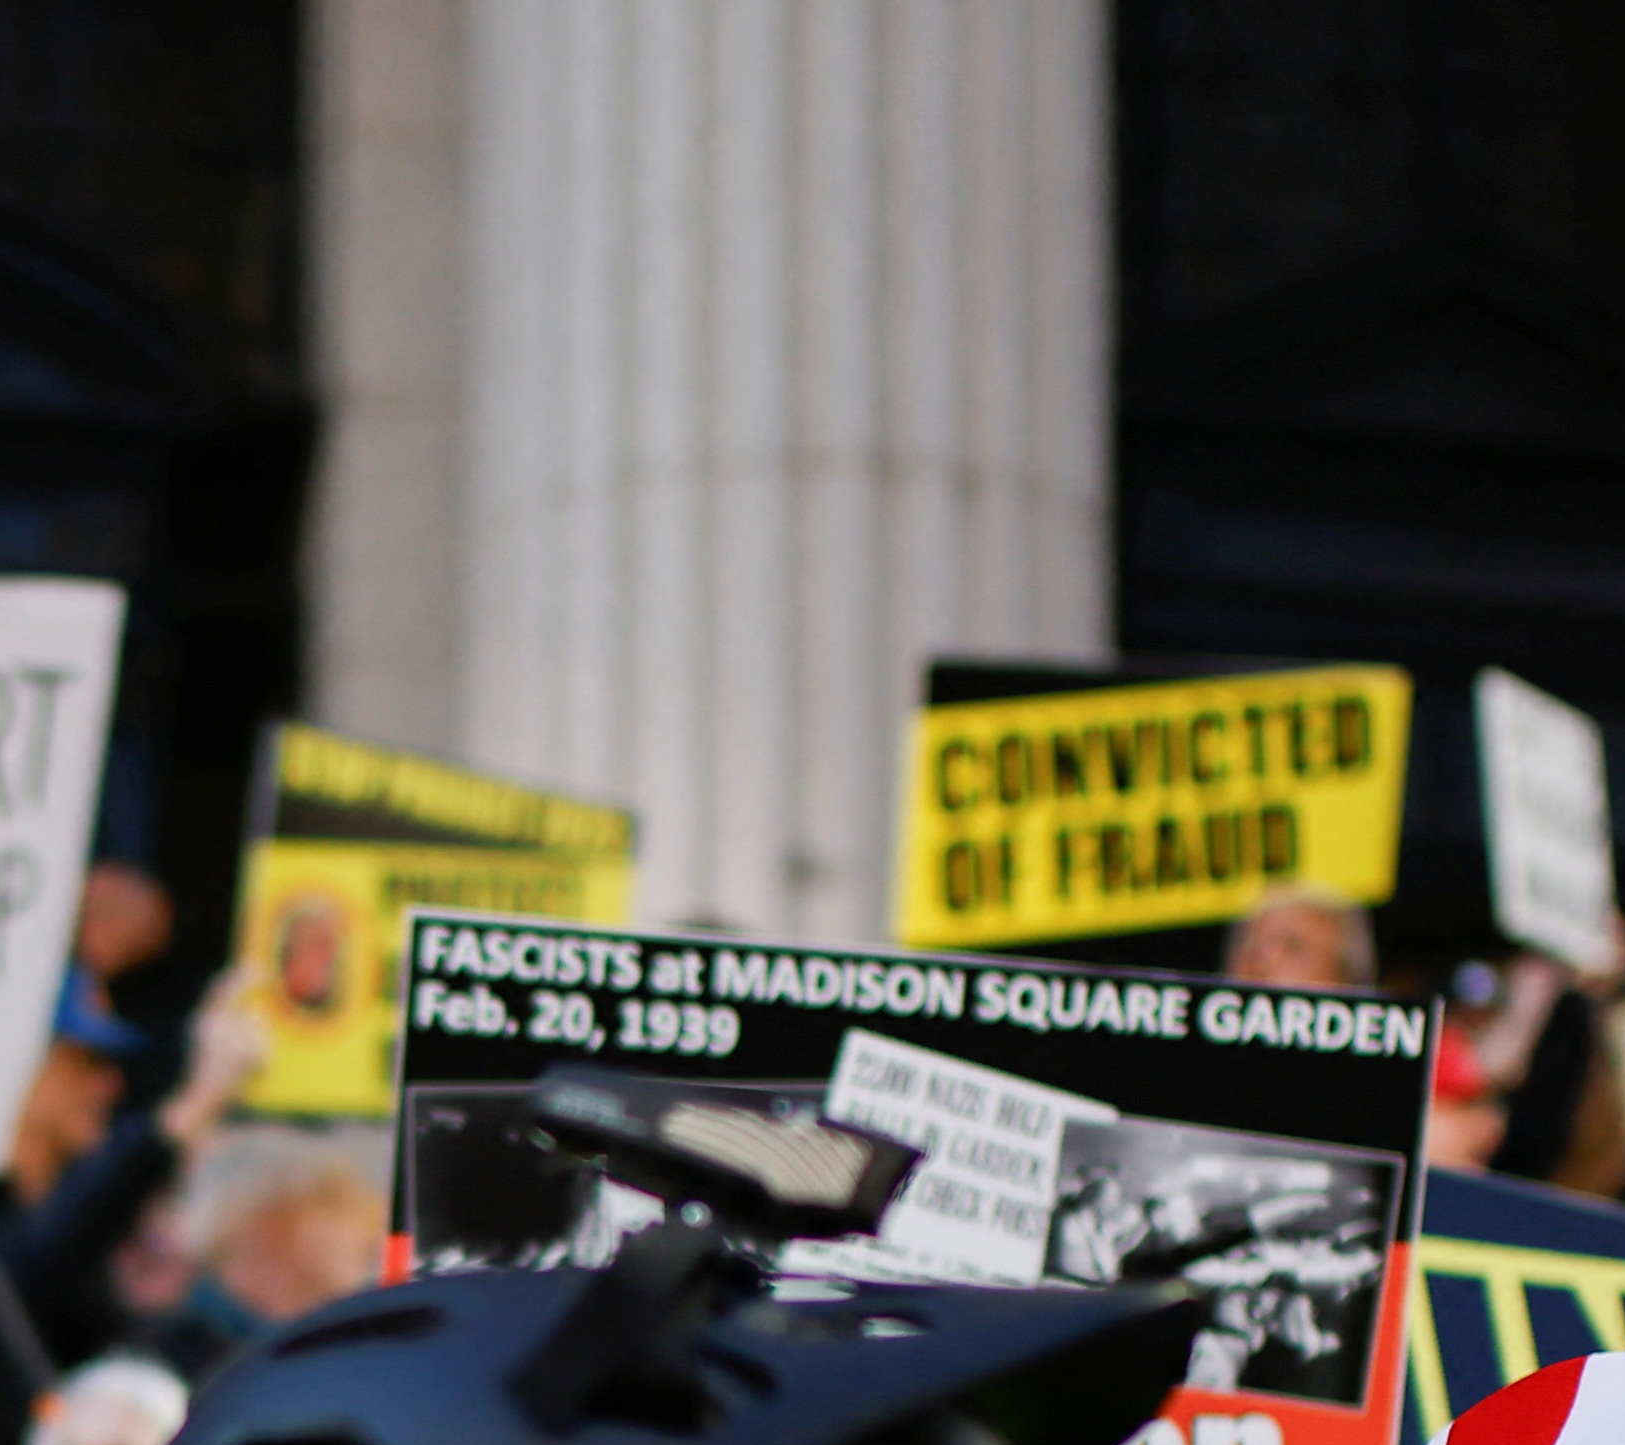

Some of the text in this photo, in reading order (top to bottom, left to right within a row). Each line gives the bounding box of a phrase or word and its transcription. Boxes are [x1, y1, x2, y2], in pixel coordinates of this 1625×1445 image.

[934, 693, 1376, 814] CONVICTED
[942, 802, 1302, 917] OF FRAUD
[415, 980, 741, 1055] Feb. 20, 1939
[420, 926, 1426, 1058] FASCISTS at MADISON SQUARE GARDEN
